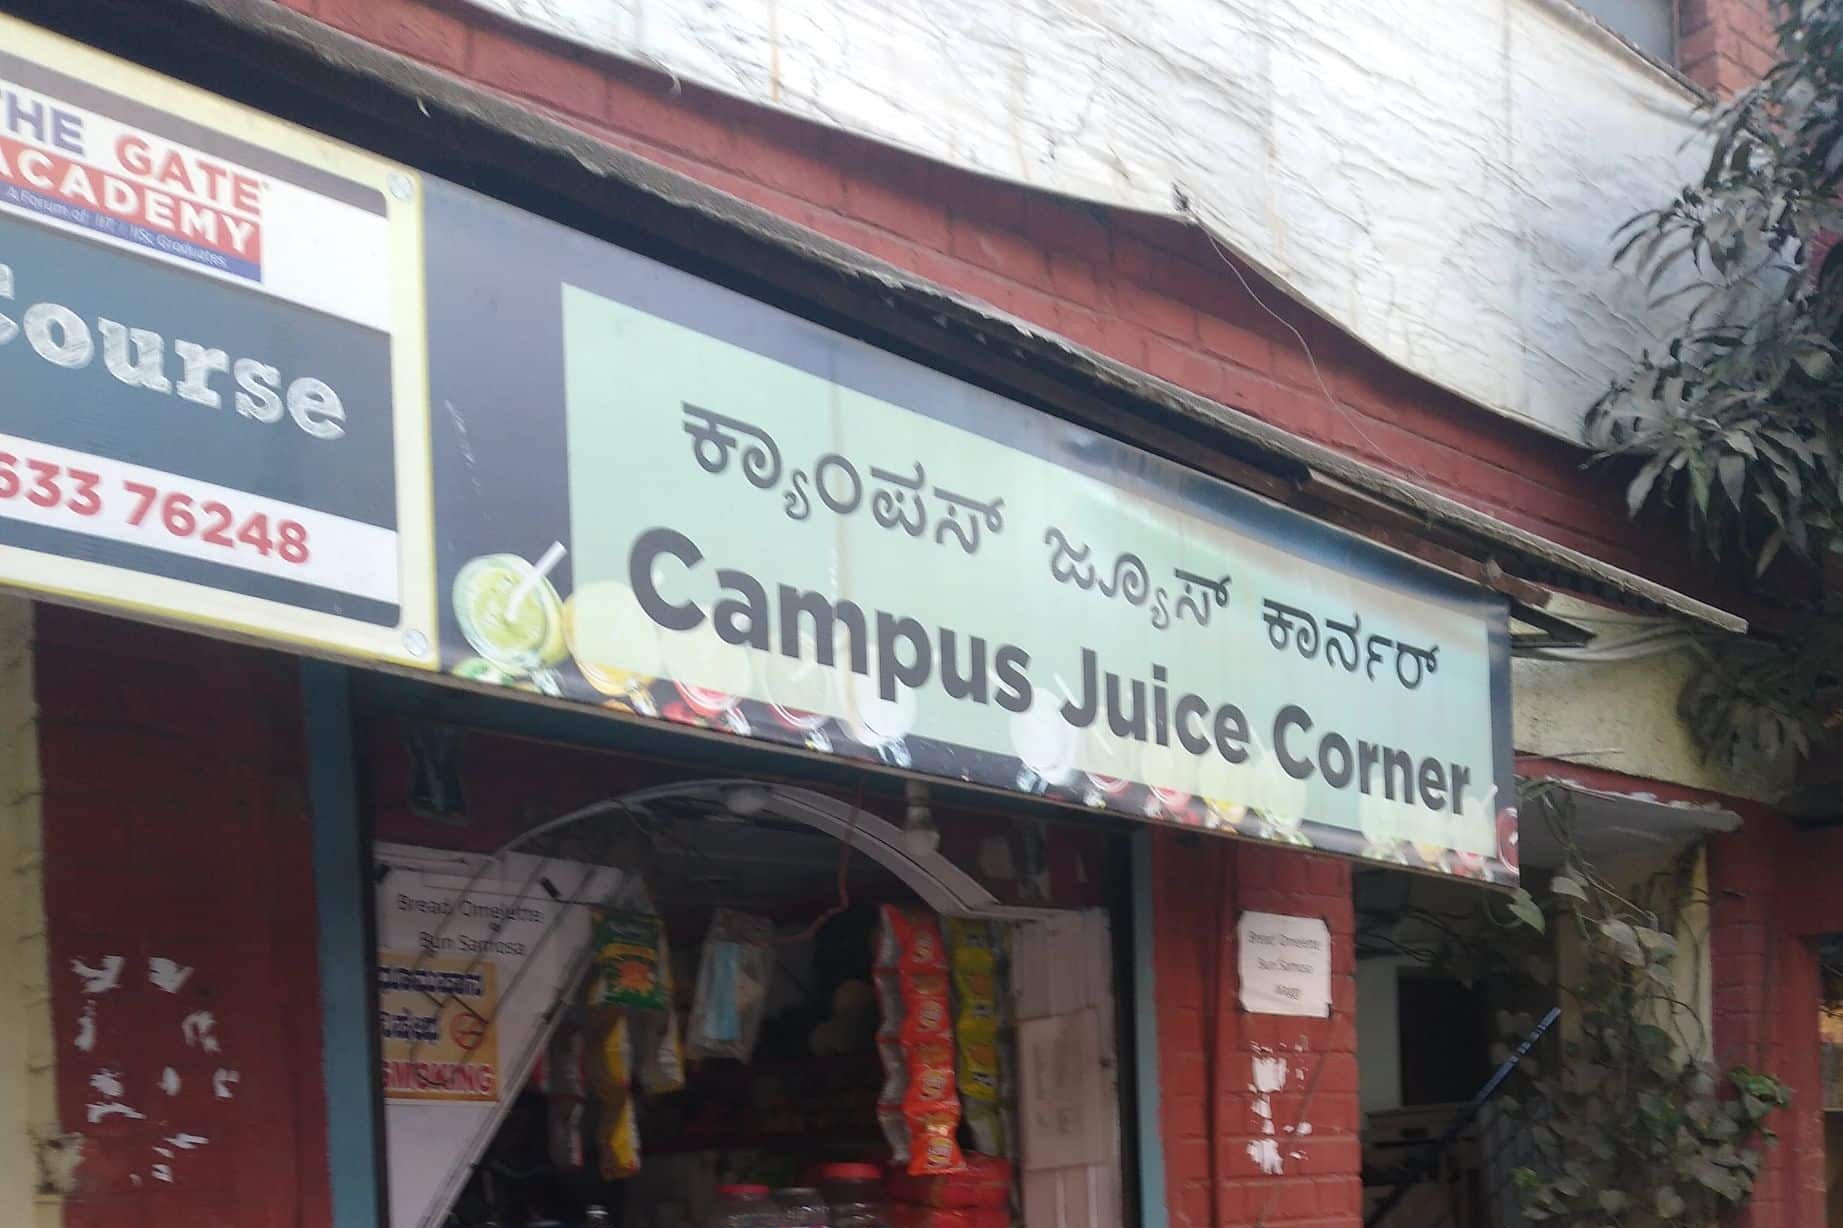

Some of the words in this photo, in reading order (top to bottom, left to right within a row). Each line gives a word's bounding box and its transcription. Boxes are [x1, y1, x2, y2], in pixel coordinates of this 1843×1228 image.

[0, 88, 83, 157] HE
[115, 134, 262, 216] GATE
[123, 481, 309, 565] 76248
[682, 400, 1004, 554] ಕ್ಯಾಂಪಸ್
[1045, 527, 1231, 630] ಜ್ಯೂಸ್
[1263, 598, 1440, 690] ಕಾರ್ನರ್
[629, 526, 1034, 713] Campus
[1061, 647, 1251, 764] Juice
[1273, 704, 1471, 816] Corner
